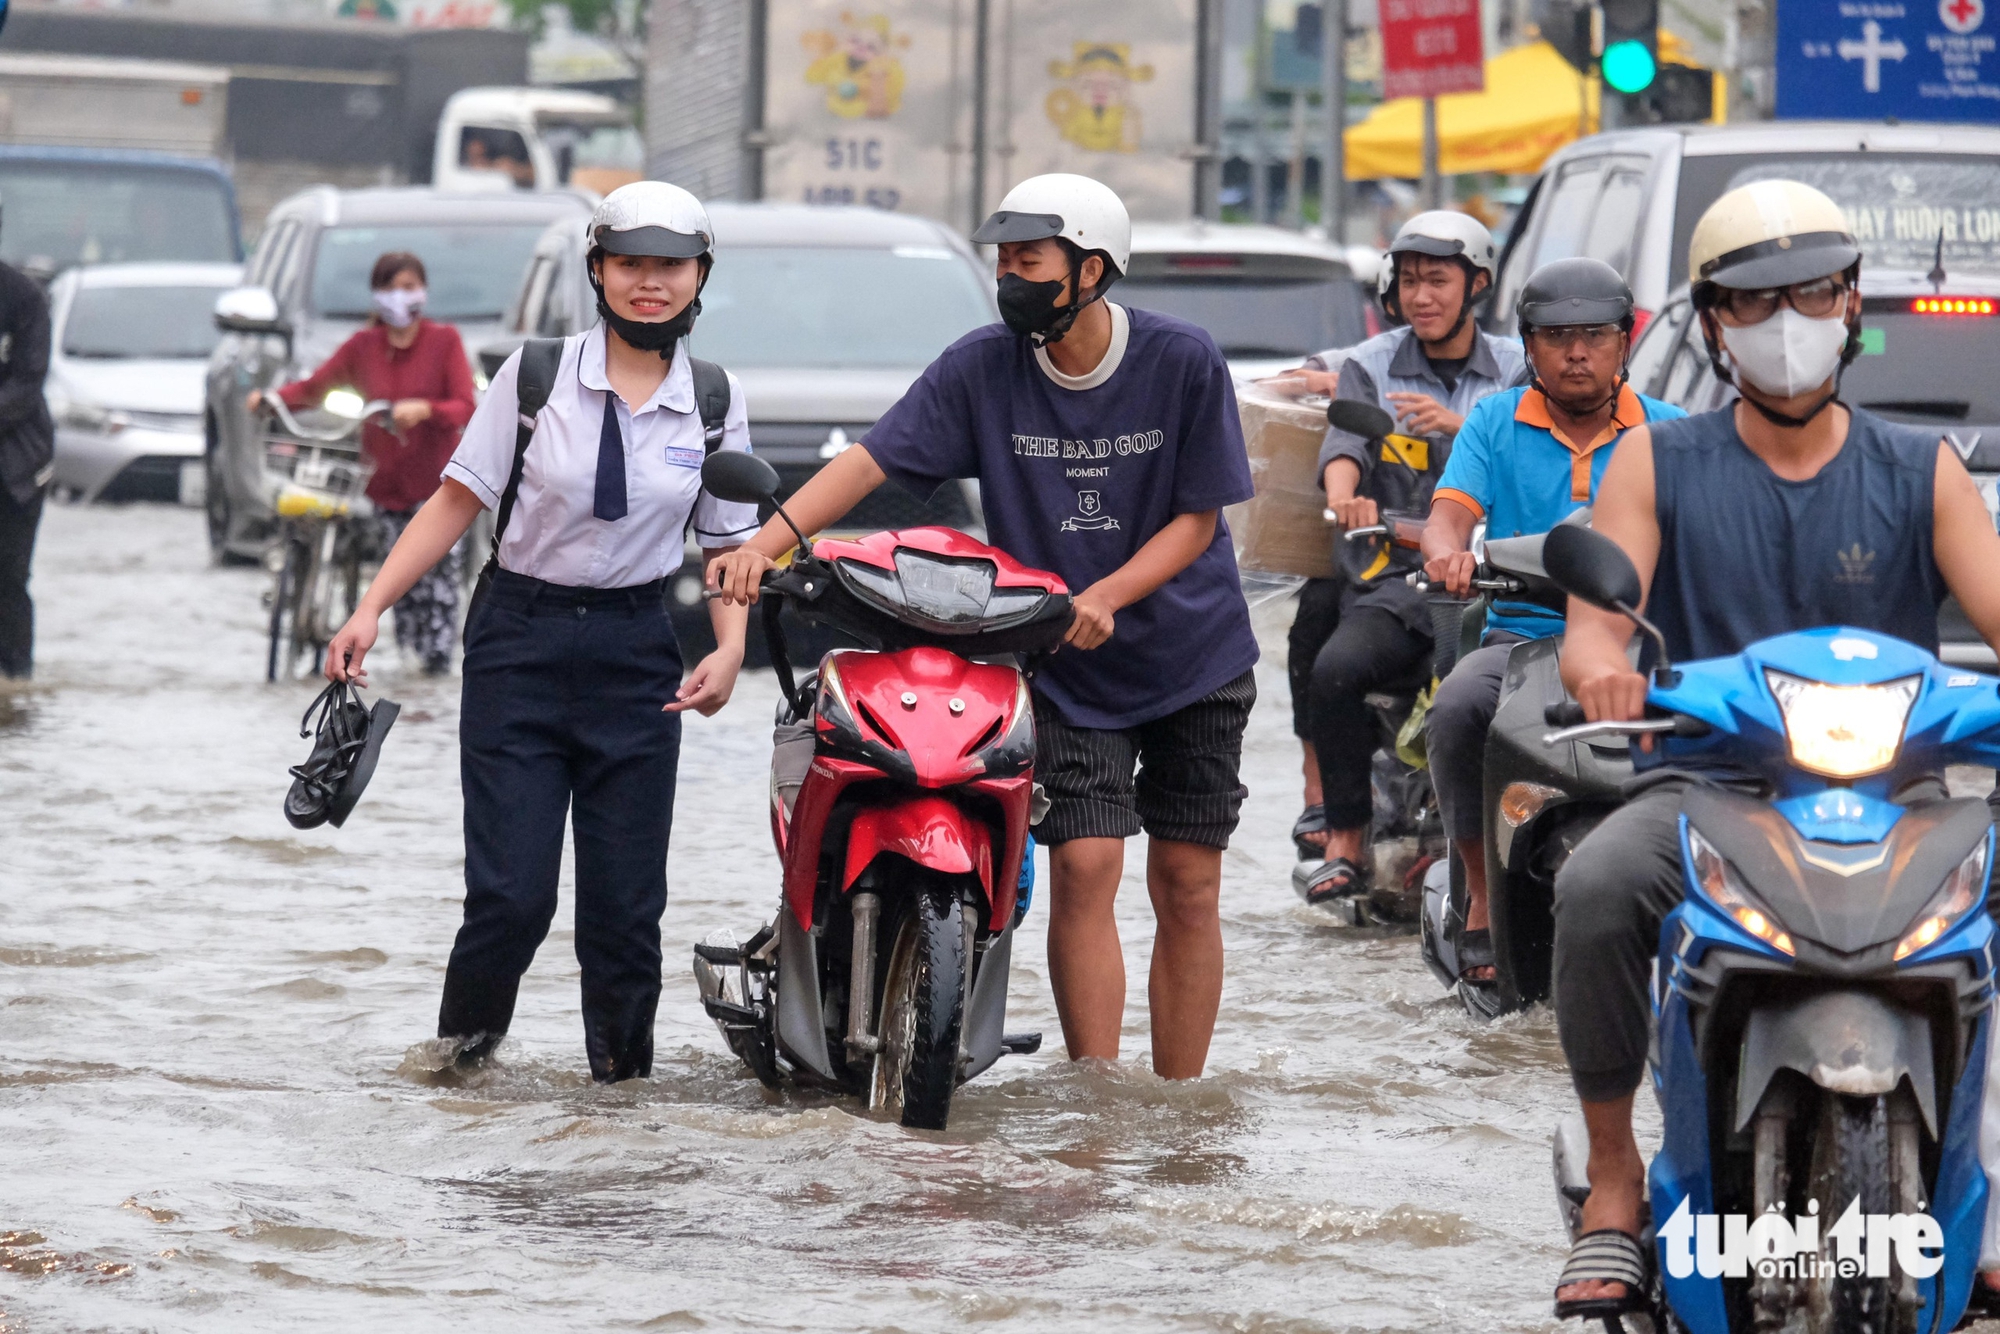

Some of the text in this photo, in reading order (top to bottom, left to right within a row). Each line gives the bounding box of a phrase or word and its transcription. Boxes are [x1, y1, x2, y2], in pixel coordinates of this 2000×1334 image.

[826, 139, 882, 170] 51C
[1011, 429, 1164, 459] THE BAD GOD
[1066, 467, 1110, 478] MOMENT
[811, 762, 835, 780] HONDA
